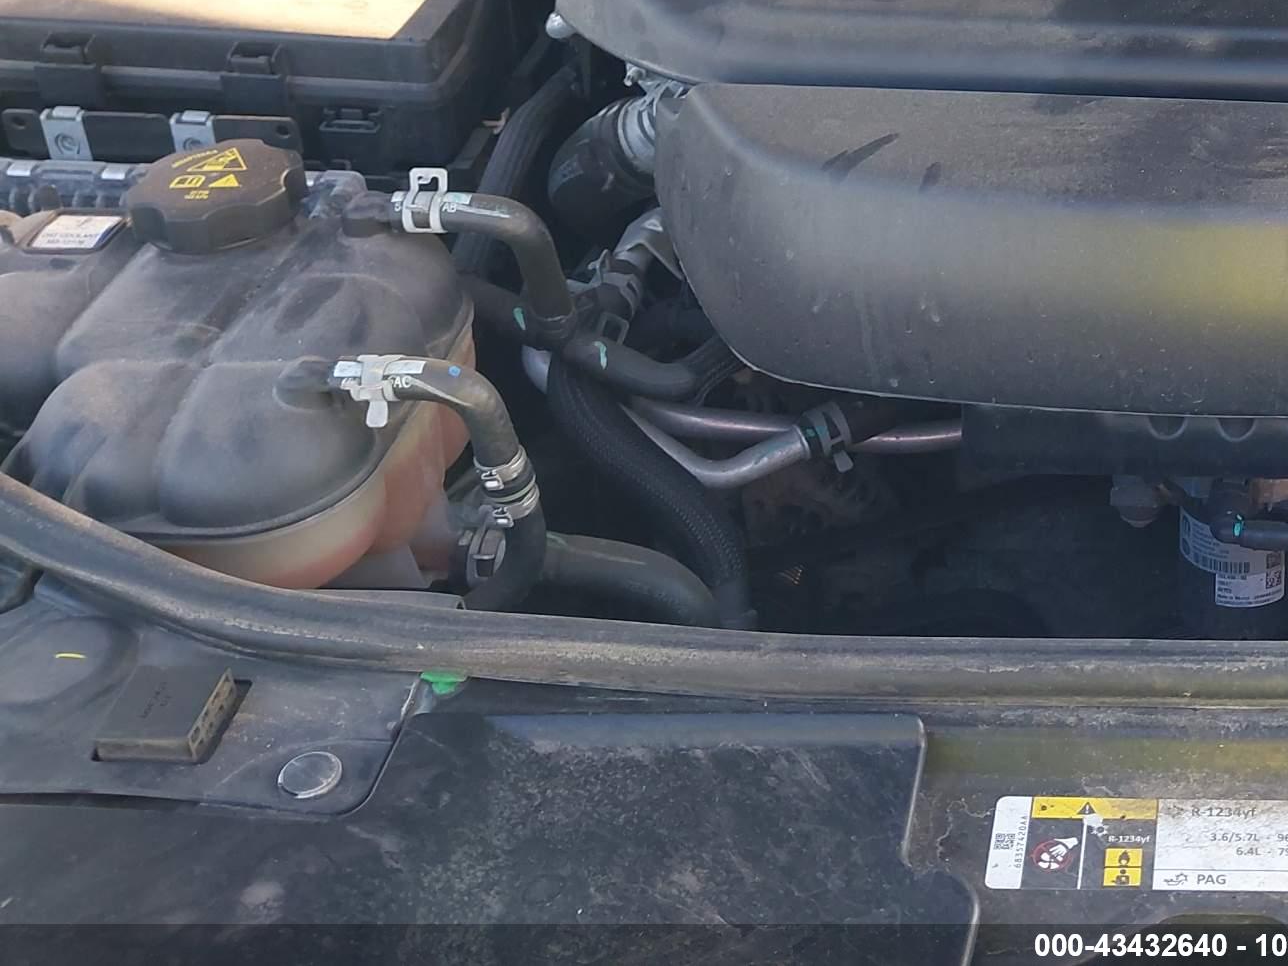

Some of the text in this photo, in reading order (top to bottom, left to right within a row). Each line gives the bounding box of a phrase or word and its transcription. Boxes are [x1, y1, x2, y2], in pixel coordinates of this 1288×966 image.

[1191, 807, 1257, 819] R-1234yf
[1108, 835, 1150, 845] R-1234yf
[1210, 833, 1261, 843] 3.6/5.7L
[1236, 847, 1262, 856] 6.4L
[1196, 874, 1227, 885] PAG
